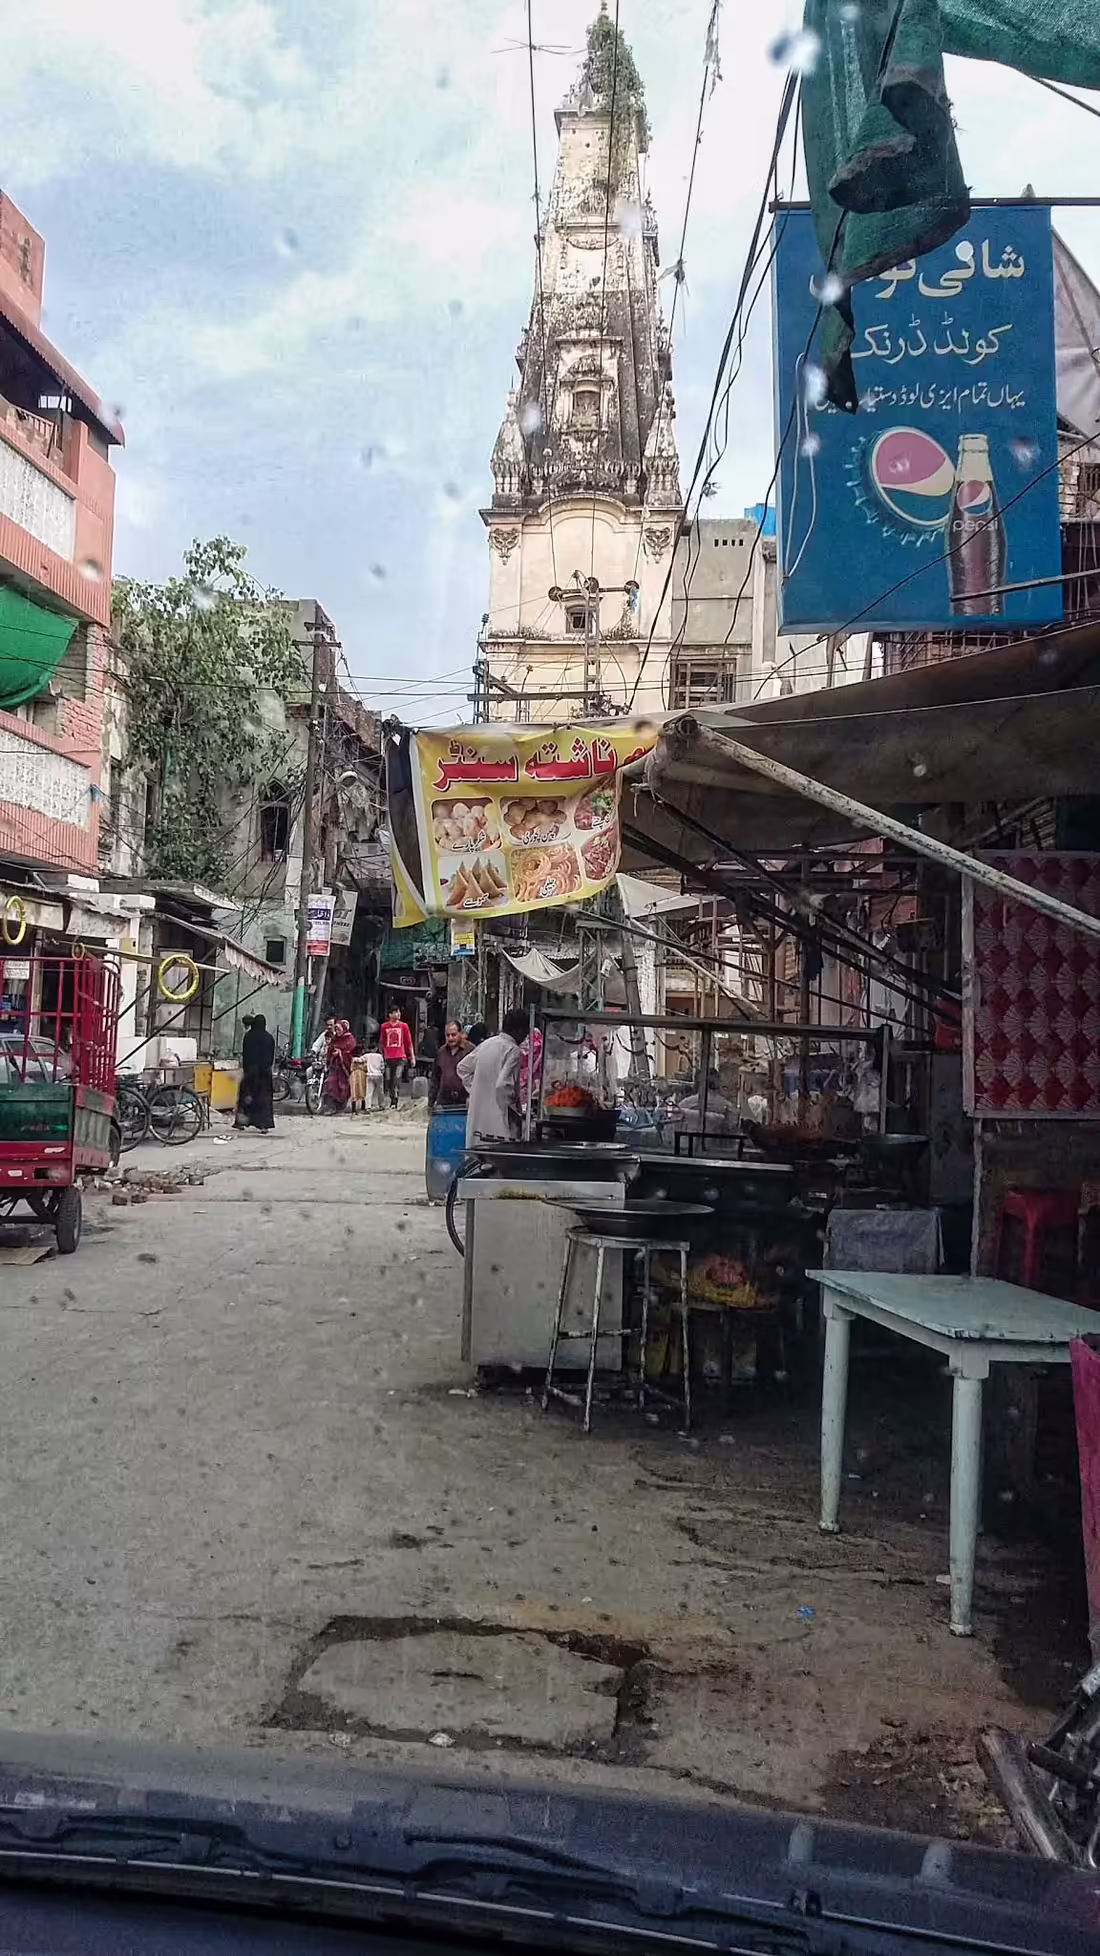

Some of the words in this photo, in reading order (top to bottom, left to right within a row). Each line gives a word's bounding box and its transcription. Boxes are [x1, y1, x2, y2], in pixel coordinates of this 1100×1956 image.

[850, 312, 928, 366] ڈرنک
[933, 311, 1013, 365] کولڈ
[859, 385, 898, 413] دستیا
[958, 381, 988, 415] تمام
[986, 383, 1026, 410] یہاں
[952, 518, 999, 532] pepsi
[432, 739, 520, 792] سنٹر
[524, 737, 618, 781] ناشتہ
